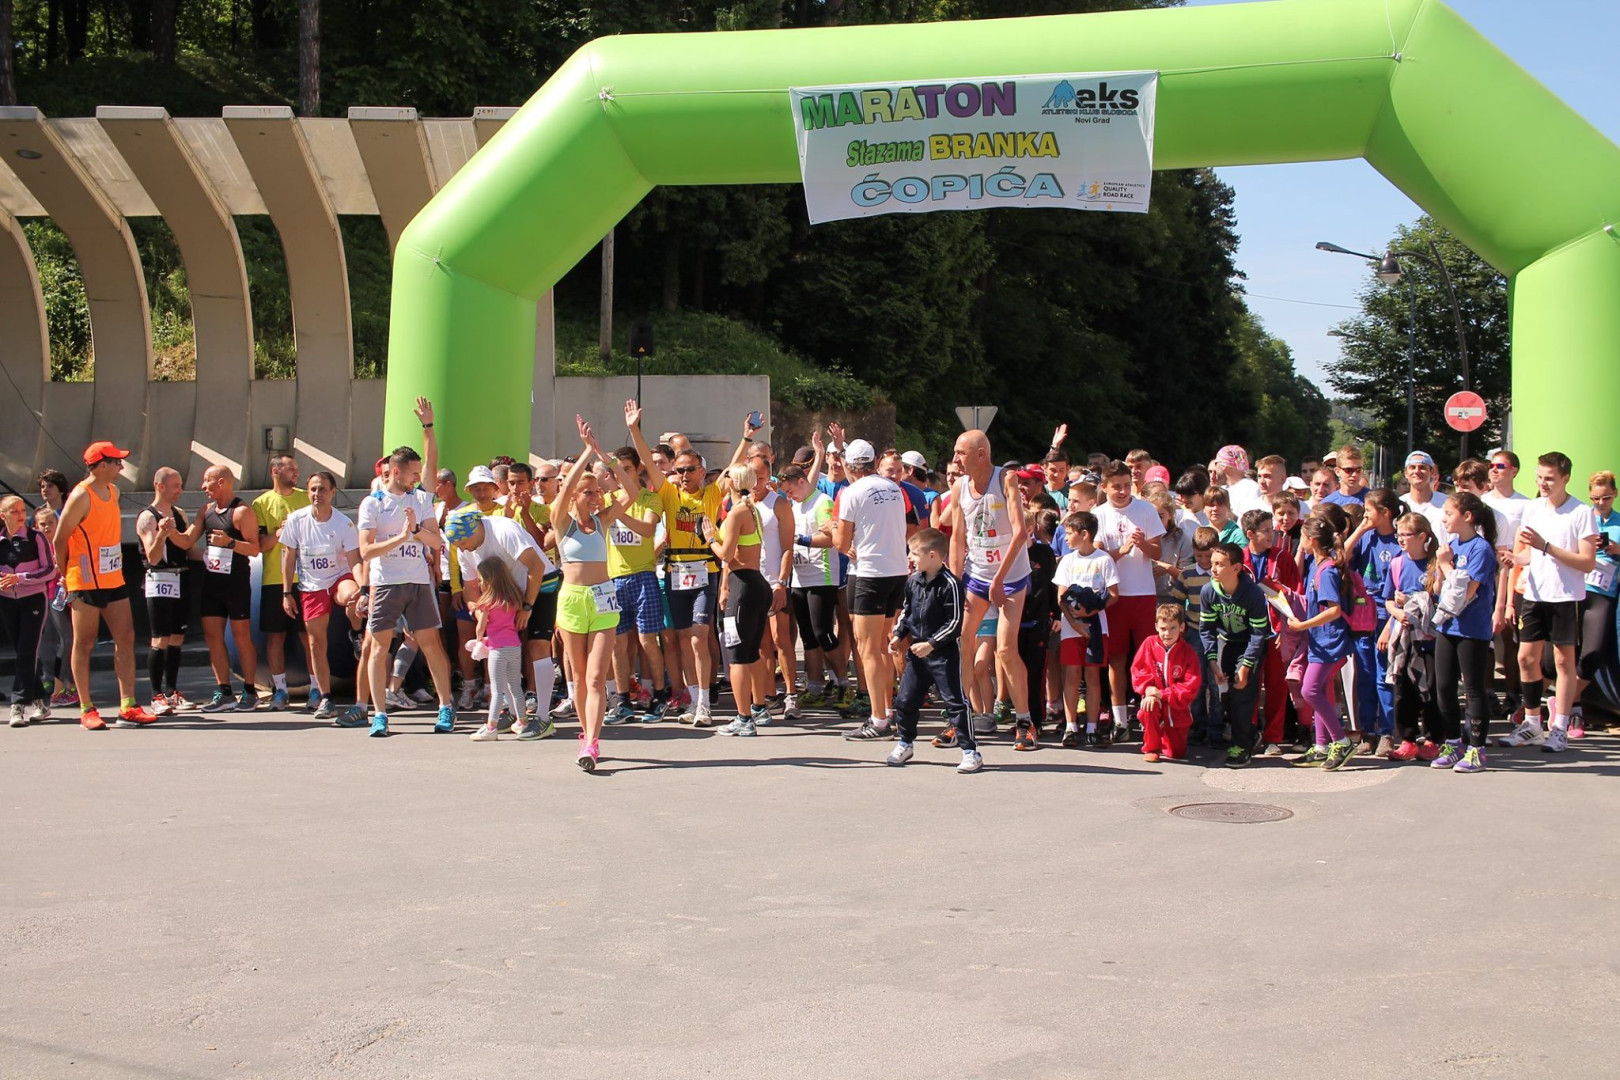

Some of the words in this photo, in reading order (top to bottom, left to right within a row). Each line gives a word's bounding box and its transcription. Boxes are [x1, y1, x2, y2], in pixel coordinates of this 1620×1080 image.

[1075, 82, 1139, 109] aks
[800, 81, 1016, 130] MARATON
[846, 139, 925, 167] Stazama
[929, 131, 1060, 160] BRANKA
[616, 531, 633, 543] 180
[400, 544, 417, 558] 143
[986, 549, 1002, 563] 51
[208, 559, 221, 571] 52
[310, 557, 329, 570] 168
[683, 574, 697, 587] 47
[155, 583, 173, 595] 167
